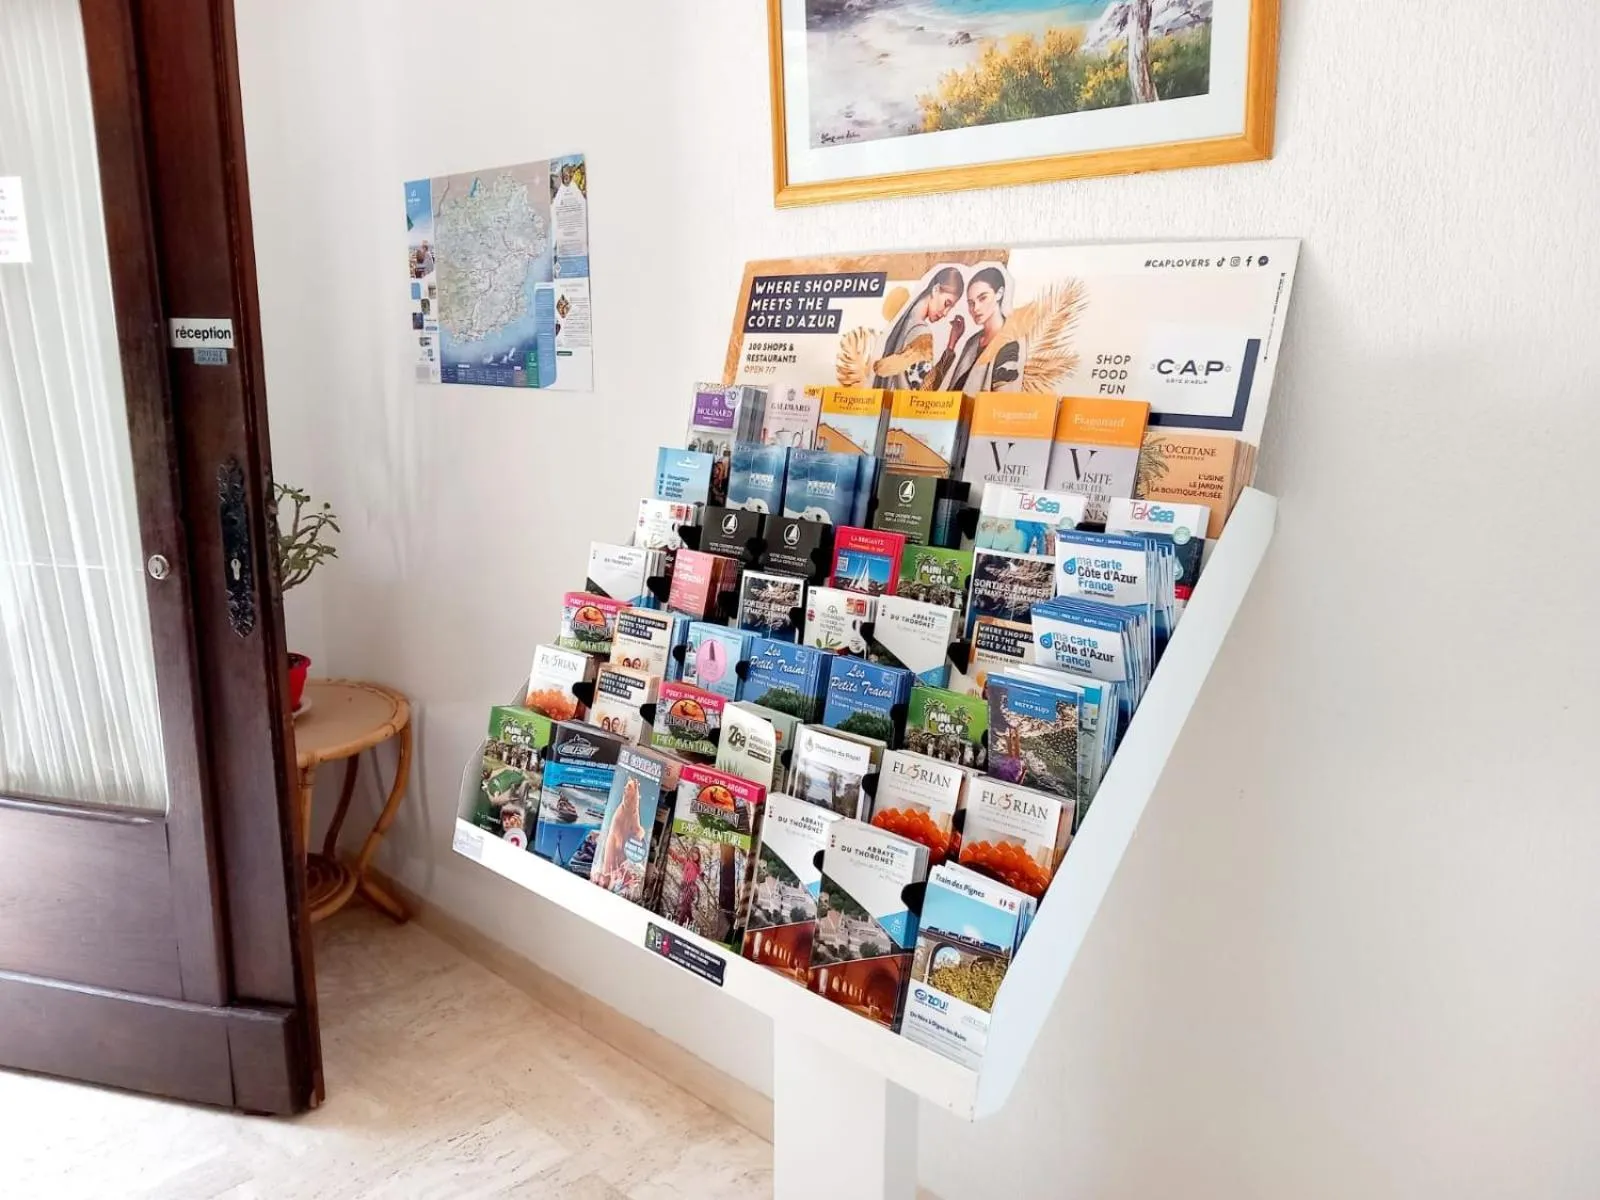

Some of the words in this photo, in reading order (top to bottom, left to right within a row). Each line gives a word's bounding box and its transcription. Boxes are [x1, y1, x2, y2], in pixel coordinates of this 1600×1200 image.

[1144, 258, 1210, 268] #CAPLOVERS
[755, 281, 801, 295] WHERE
[803, 278, 880, 293] SHOPPING
[751, 298, 793, 311] MEETS
[798, 298, 824, 310] THE
[747, 312, 782, 328] CÔTE
[785, 314, 836, 328] D'AZUR
[175, 325, 231, 341] réception
[748, 342, 762, 351] 100
[762, 342, 787, 351] SHOPS
[746, 353, 797, 363] RESTAURANTS
[1096, 354, 1131, 365] SHOP
[744, 365, 764, 373] OPEN
[1091, 368, 1128, 380] FOOD
[1099, 383, 1126, 394] FUN
[909, 395, 955, 409] Fragonard
[1158, 443, 1217, 457] L'OCCITANE
[1070, 448, 1113, 485] VISITE
[1198, 474, 1224, 482] L'USINE
[1198, 481, 1224, 490] JARDIN
[1017, 492, 1061, 514] TakSea
[1130, 501, 1175, 524] TakSea
[921, 564, 942, 575] MINI
[1077, 558, 1092, 567] ma
[1094, 559, 1122, 570] carte
[1078, 565, 1101, 579] Côte
[1104, 570, 1138, 585] d'Azur
[1078, 577, 1114, 592] France
[980, 625, 1002, 636] WHERE
[1001, 636, 1015, 645] THE
[1053, 632, 1069, 642] ma
[1070, 635, 1098, 648] carte
[764, 642, 781, 657] Les
[1054, 640, 1078, 655] Côte
[1080, 646, 1116, 663] d'Azur
[749, 655, 774, 671] Petits
[777, 659, 806, 676] Trains
[1055, 651, 1091, 668] France
[847, 663, 866, 678] Les
[830, 676, 858, 692] Petits
[862, 681, 893, 698] Trains
[930, 711, 950, 725] MINI
[777, 815, 788, 824] DU
[789, 819, 823, 835] THORONET
[801, 815, 824, 828] ABBAYE
[841, 844, 852, 853] DU
[854, 848, 895, 866] THORONET
[867, 845, 896, 859] ABBAYE
[935, 873, 951, 886] Train
[951, 879, 963, 890] des
[963, 883, 985, 898] Pignes
